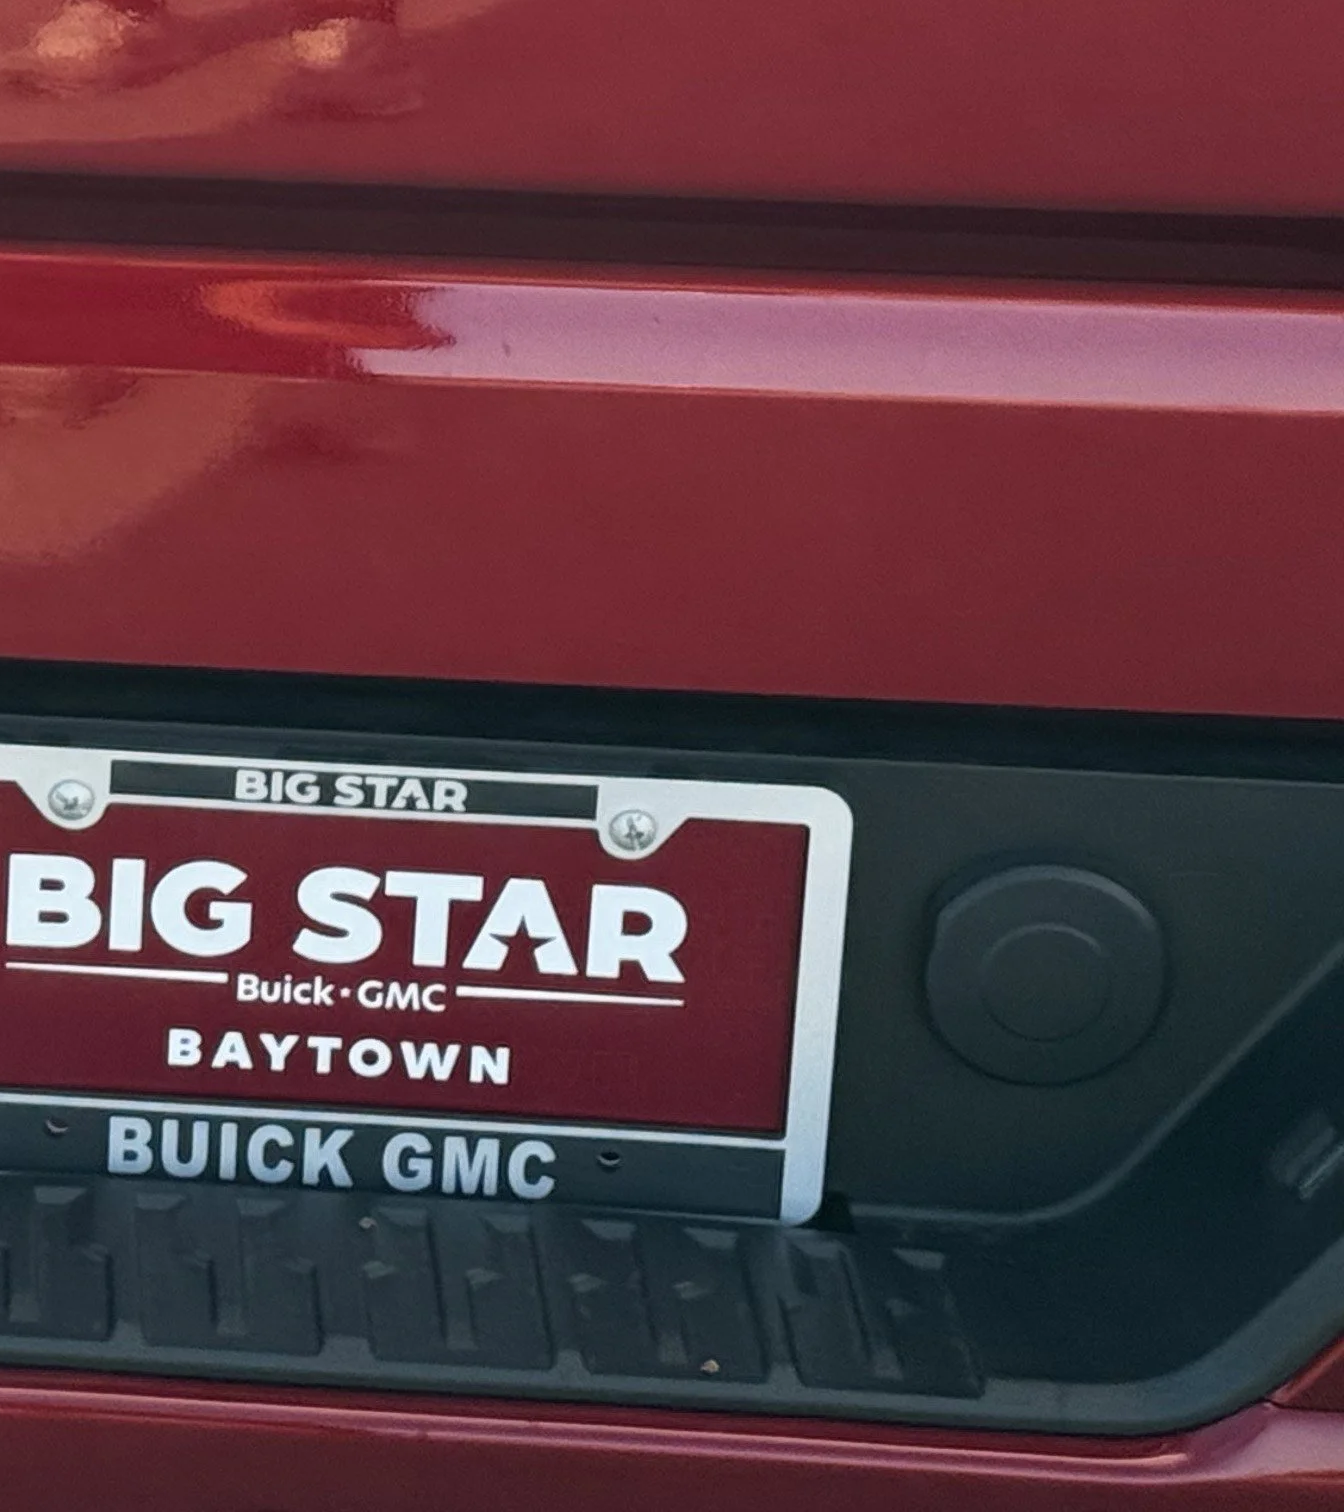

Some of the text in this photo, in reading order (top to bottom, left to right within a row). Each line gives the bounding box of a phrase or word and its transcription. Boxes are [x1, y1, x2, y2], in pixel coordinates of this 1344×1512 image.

[234, 769, 468, 813] BIG STAR
[6, 853, 688, 982] BIG STAR
[236, 973, 447, 1013] Buick GMC
[166, 1028, 511, 1085] BAYTOWN
[107, 1114, 557, 1200] BUICK GMC
